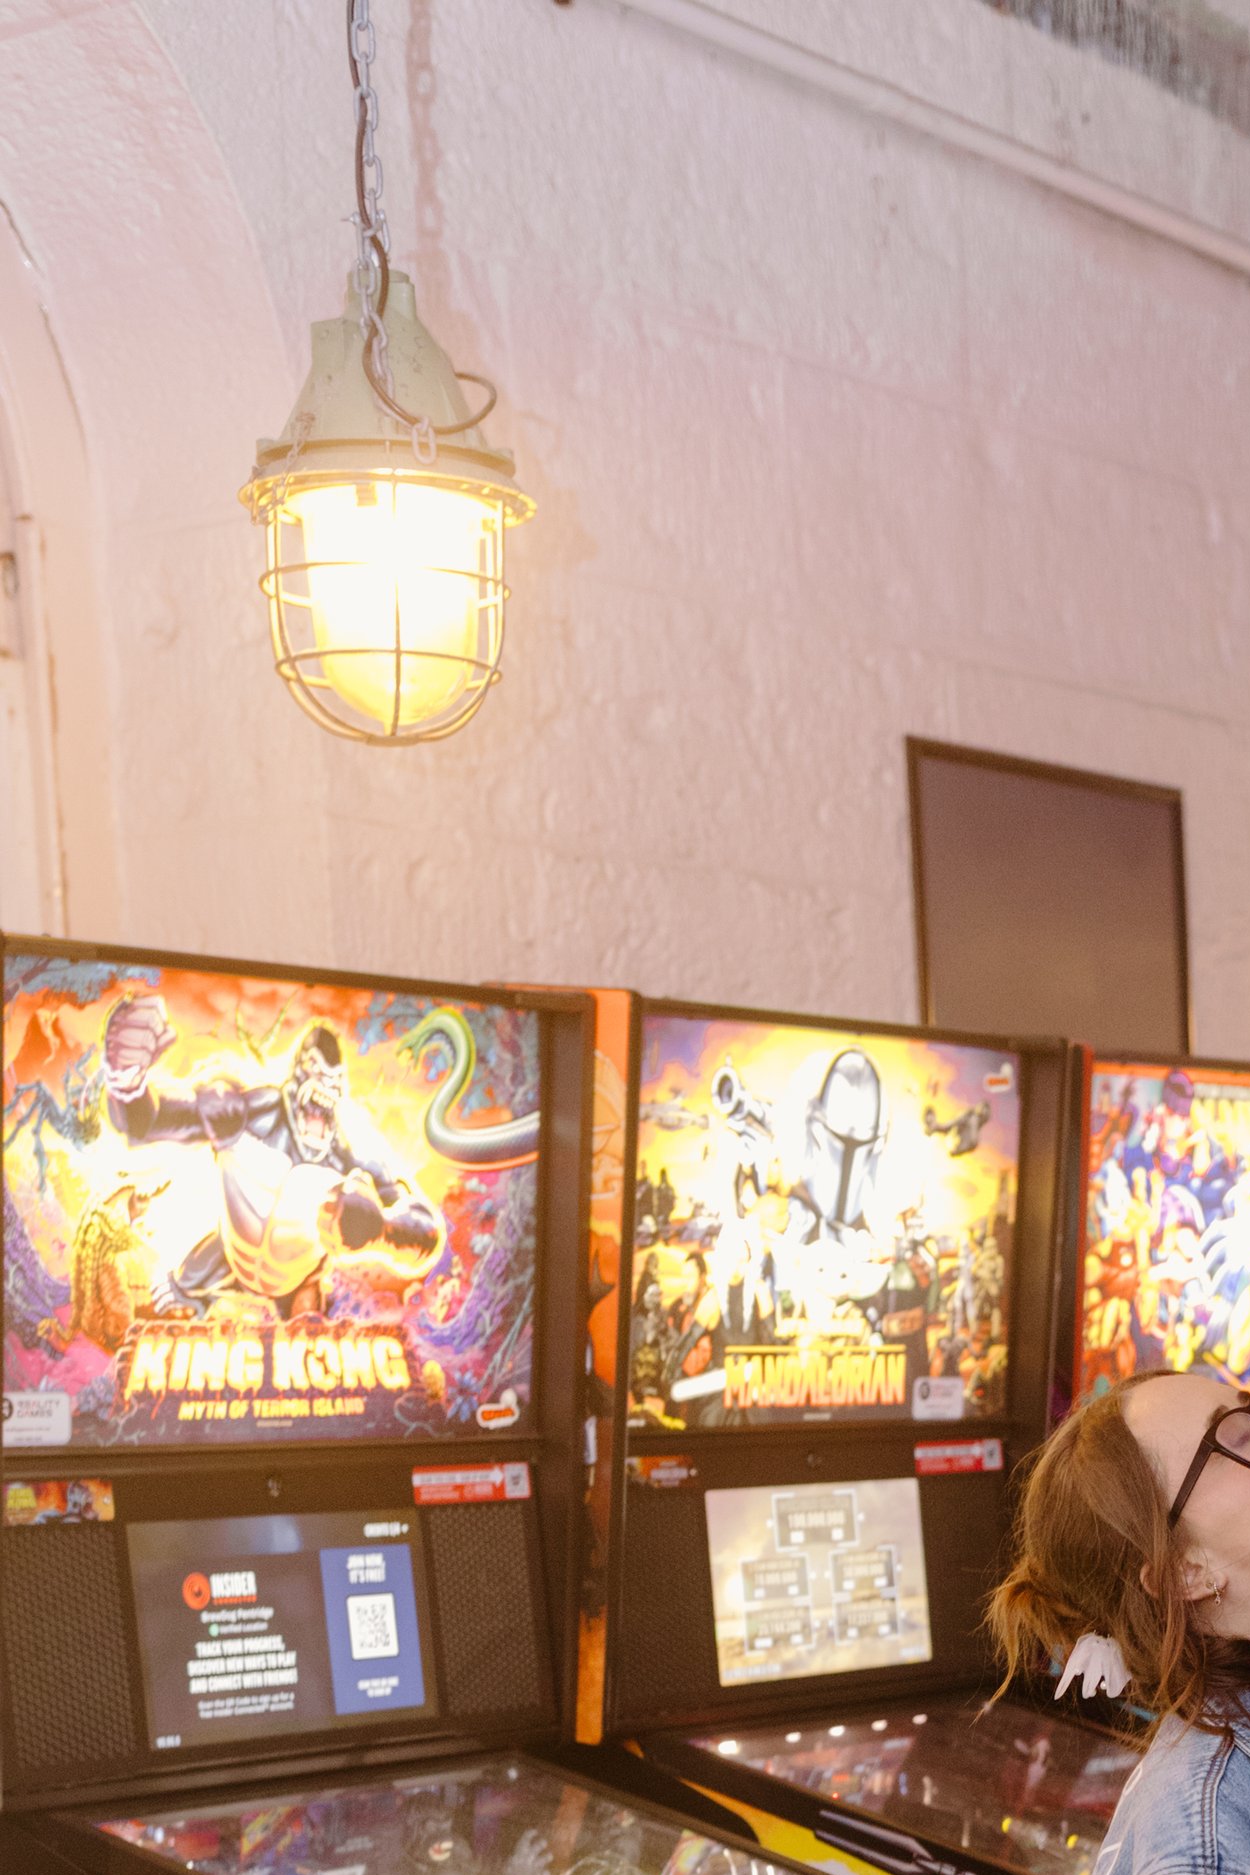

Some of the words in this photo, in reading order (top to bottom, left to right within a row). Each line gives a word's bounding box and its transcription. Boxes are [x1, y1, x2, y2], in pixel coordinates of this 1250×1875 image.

[126, 1336, 264, 1392] KING
[272, 1336, 411, 1391] KONG
[724, 1352, 907, 1409] MANDALORIAN
[178, 1400, 227, 1420] MYTH
[227, 1399, 249, 1419] OF
[253, 1398, 310, 1418] TERROR
[313, 1397, 366, 1417] ISLAND
[210, 1571, 257, 1598] INSIDER
[277, 1651, 297, 1667] PLAY
